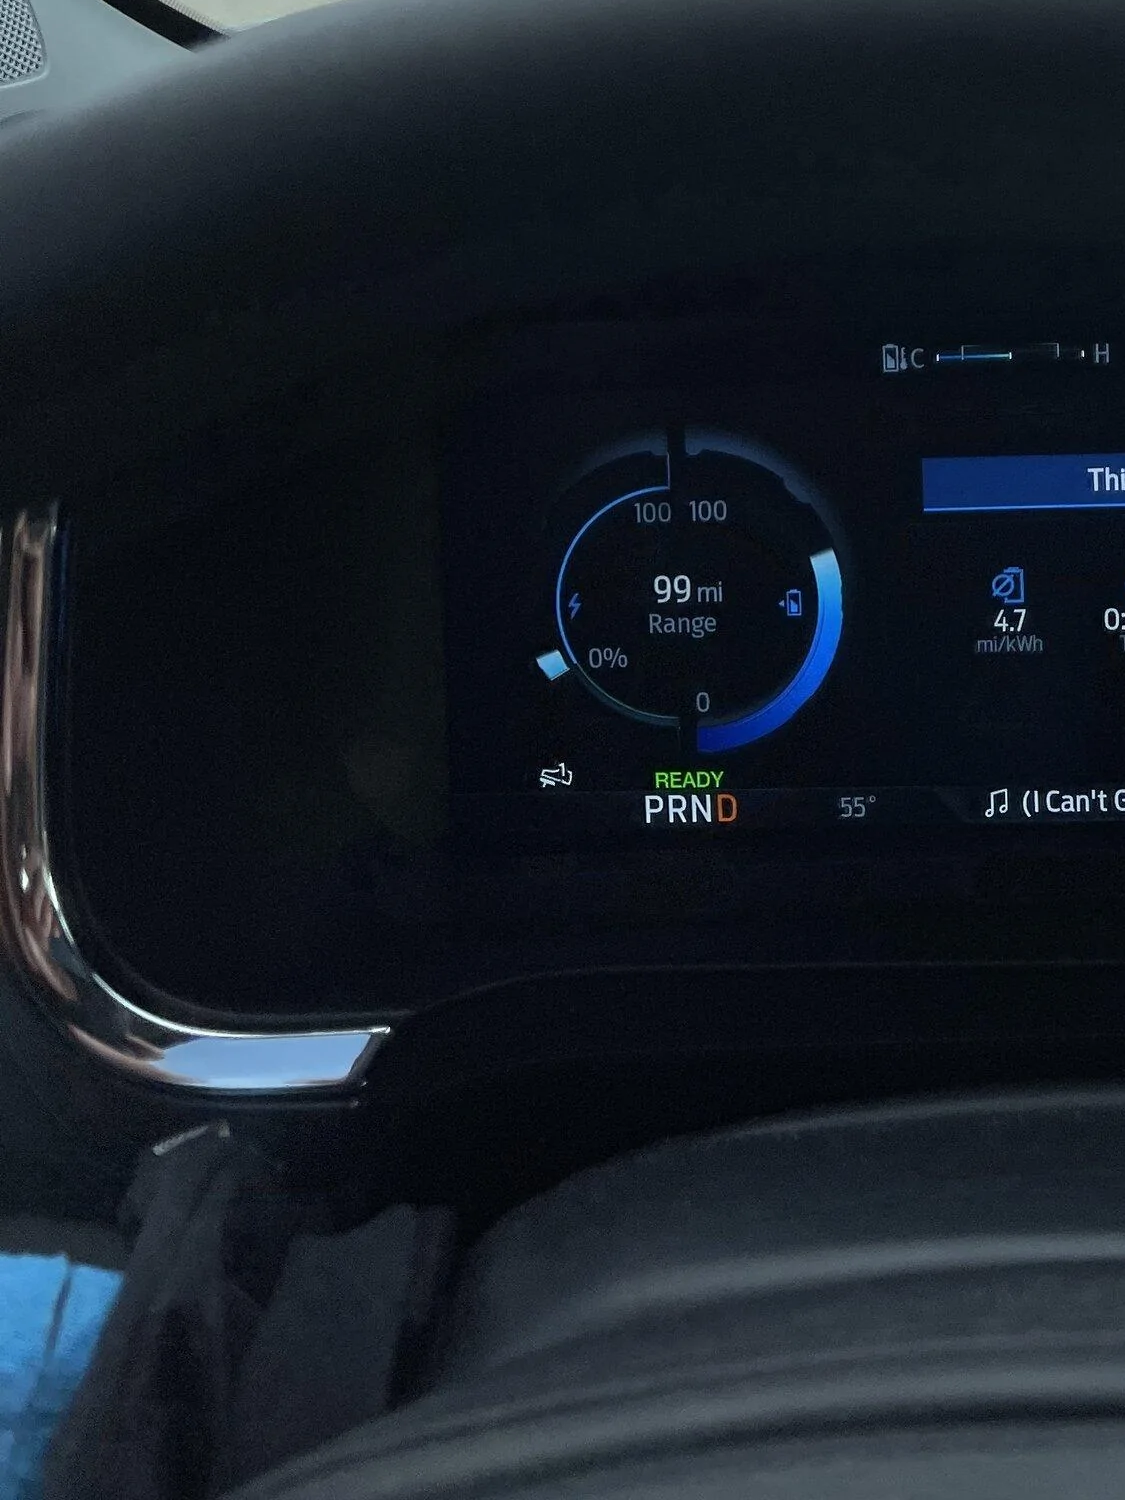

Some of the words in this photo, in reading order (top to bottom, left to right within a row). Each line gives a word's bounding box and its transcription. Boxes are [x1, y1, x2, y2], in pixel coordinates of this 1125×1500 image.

[910, 347, 925, 369] C
[1095, 343, 1110, 364] H
[634, 502, 672, 524] 100
[689, 499, 728, 523] 100
[653, 574, 691, 604] 99
[697, 580, 724, 603] mi
[648, 613, 717, 639] Range
[993, 608, 1028, 633] 4.7
[976, 635, 1043, 654] mi/kWh
[587, 646, 629, 670] 0%
[695, 691, 711, 713] 0
[655, 770, 724, 789] READY
[1045, 789, 1108, 813] Can't
